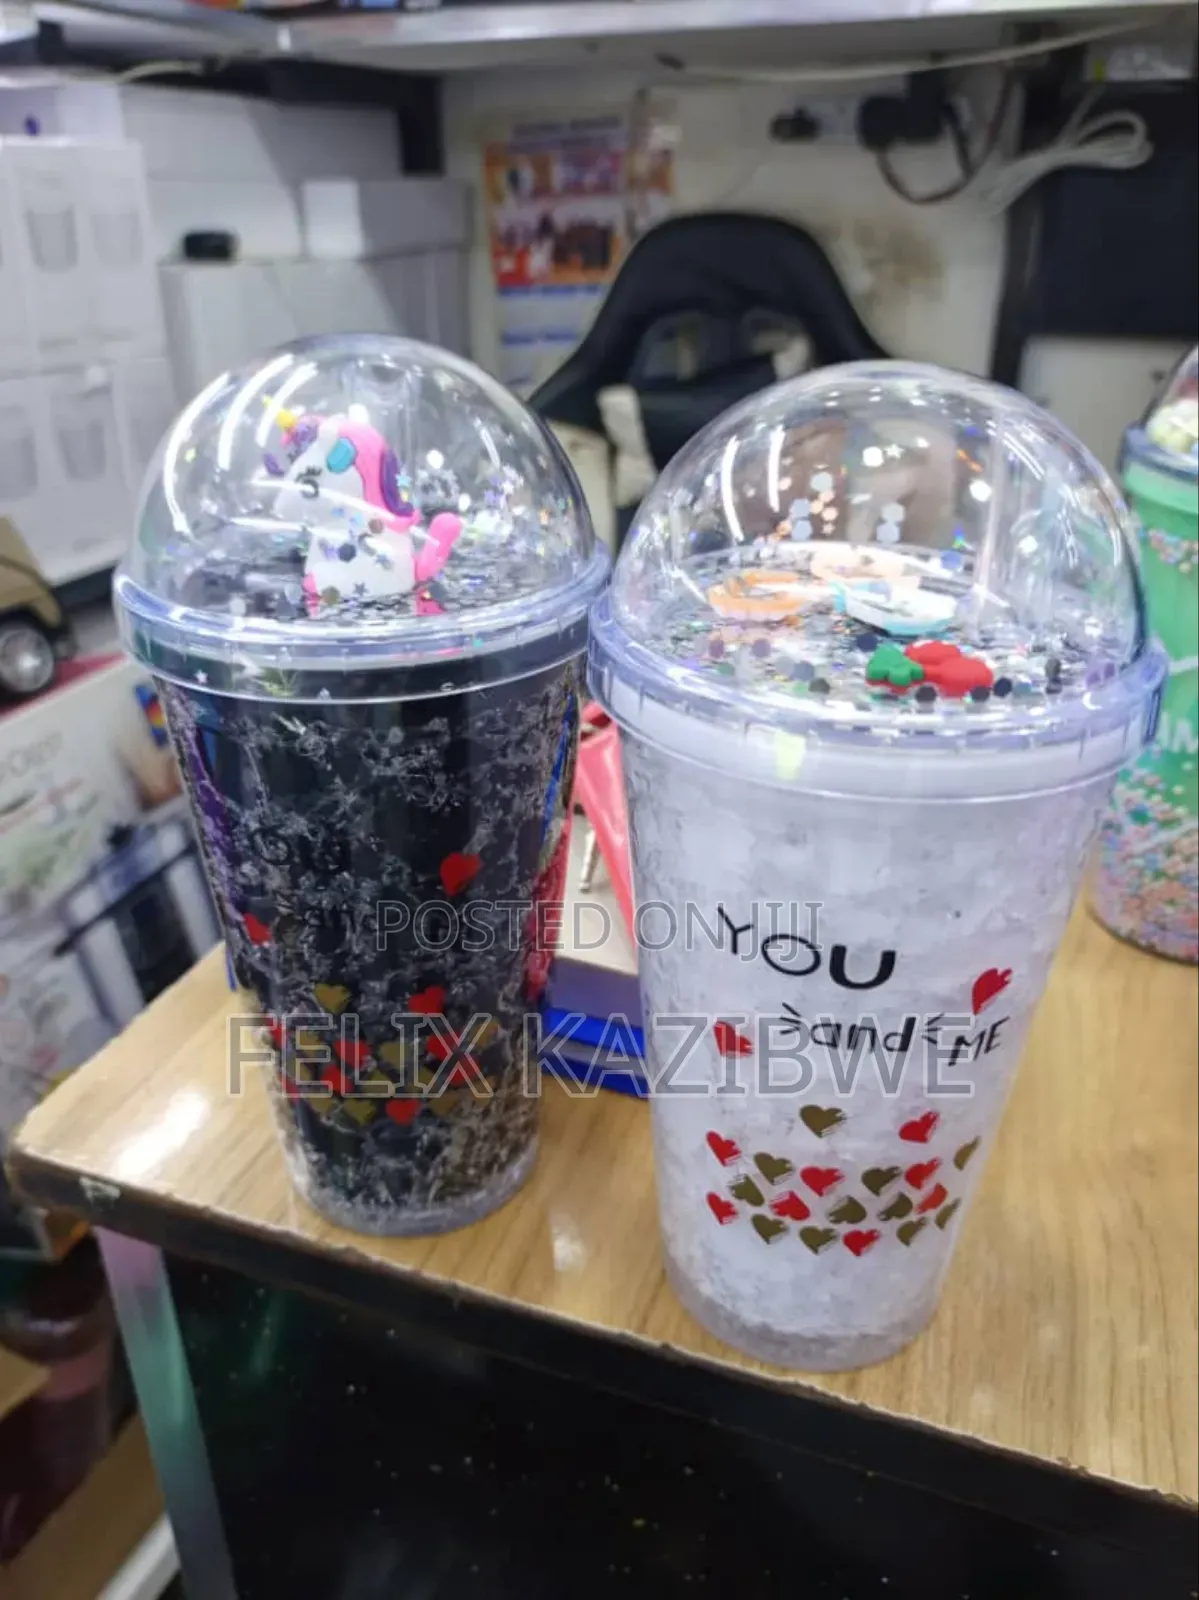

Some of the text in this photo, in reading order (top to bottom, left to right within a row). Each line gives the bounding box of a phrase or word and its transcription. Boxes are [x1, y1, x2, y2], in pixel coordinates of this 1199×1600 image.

[717, 905, 897, 990] YOU
[809, 1016, 1011, 1067] and ME
